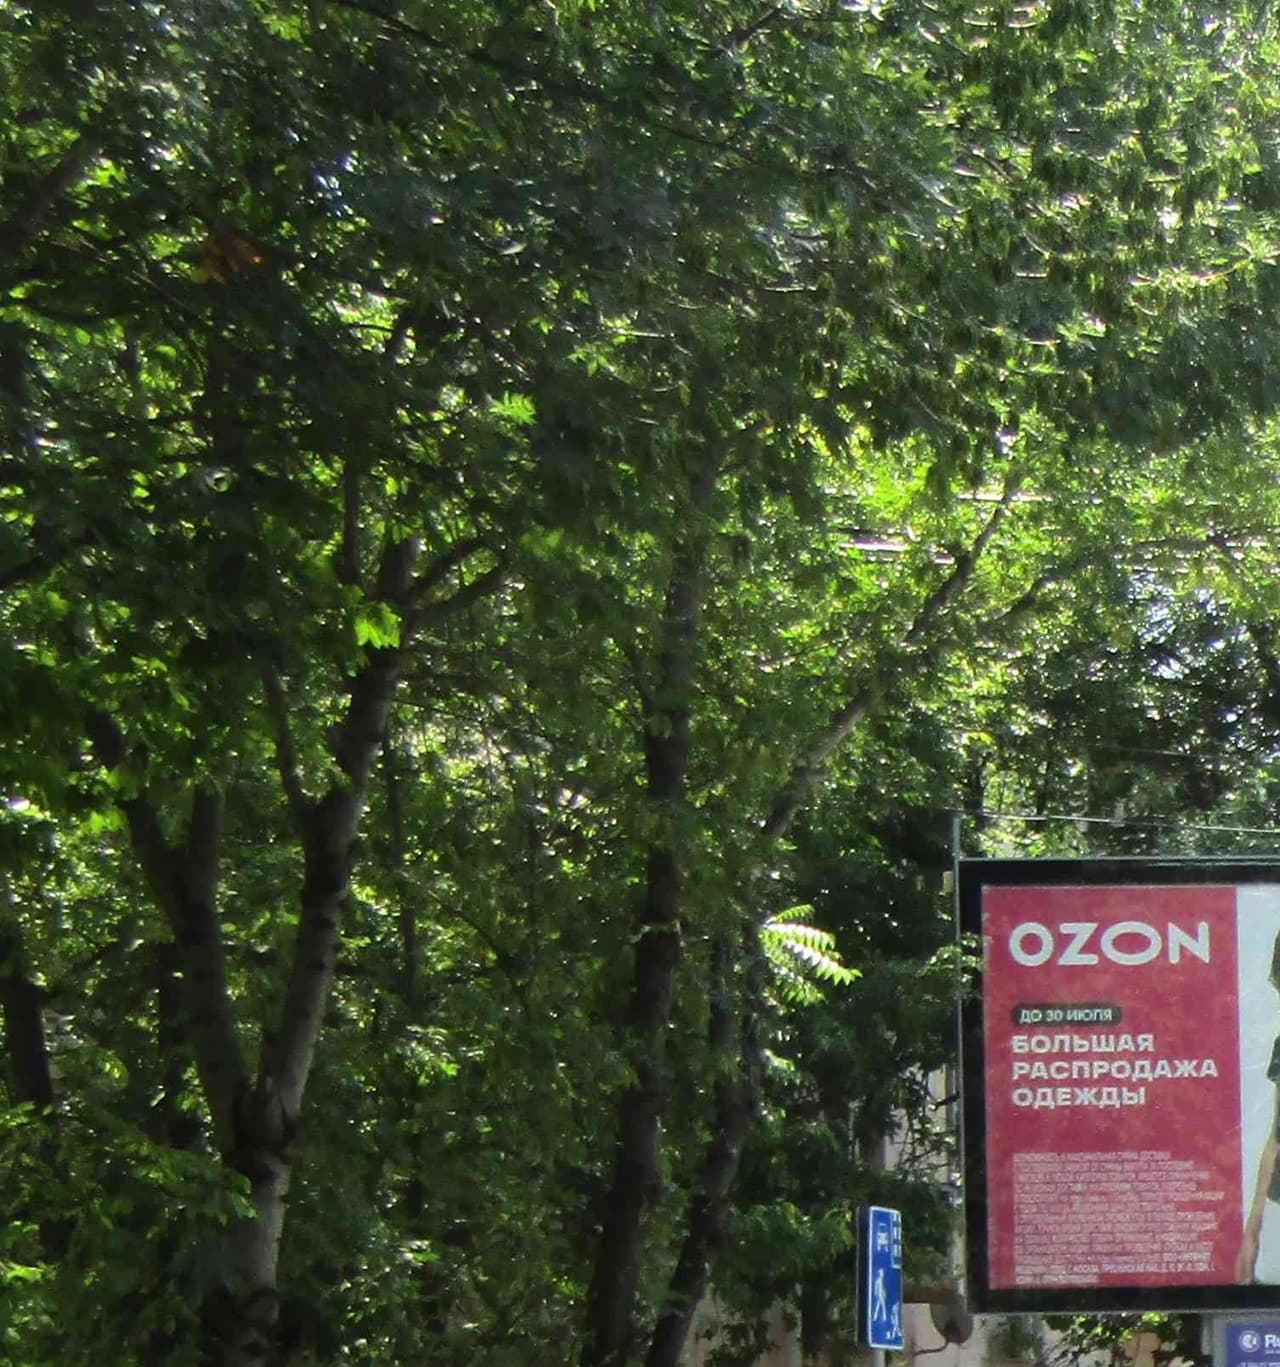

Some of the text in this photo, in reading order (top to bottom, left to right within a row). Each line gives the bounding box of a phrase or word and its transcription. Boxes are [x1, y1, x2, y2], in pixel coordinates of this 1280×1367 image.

[1009, 921, 1211, 968] OZON
[1019, 1008, 1113, 1024] ДО 30 ИЮЛЯ
[1011, 1033, 1155, 1053] БОЛЬШАЯ
[1012, 1059, 1219, 1083] РАСПРОДАЖА
[1012, 1087, 1147, 1109] ОДЕЖДЫ
